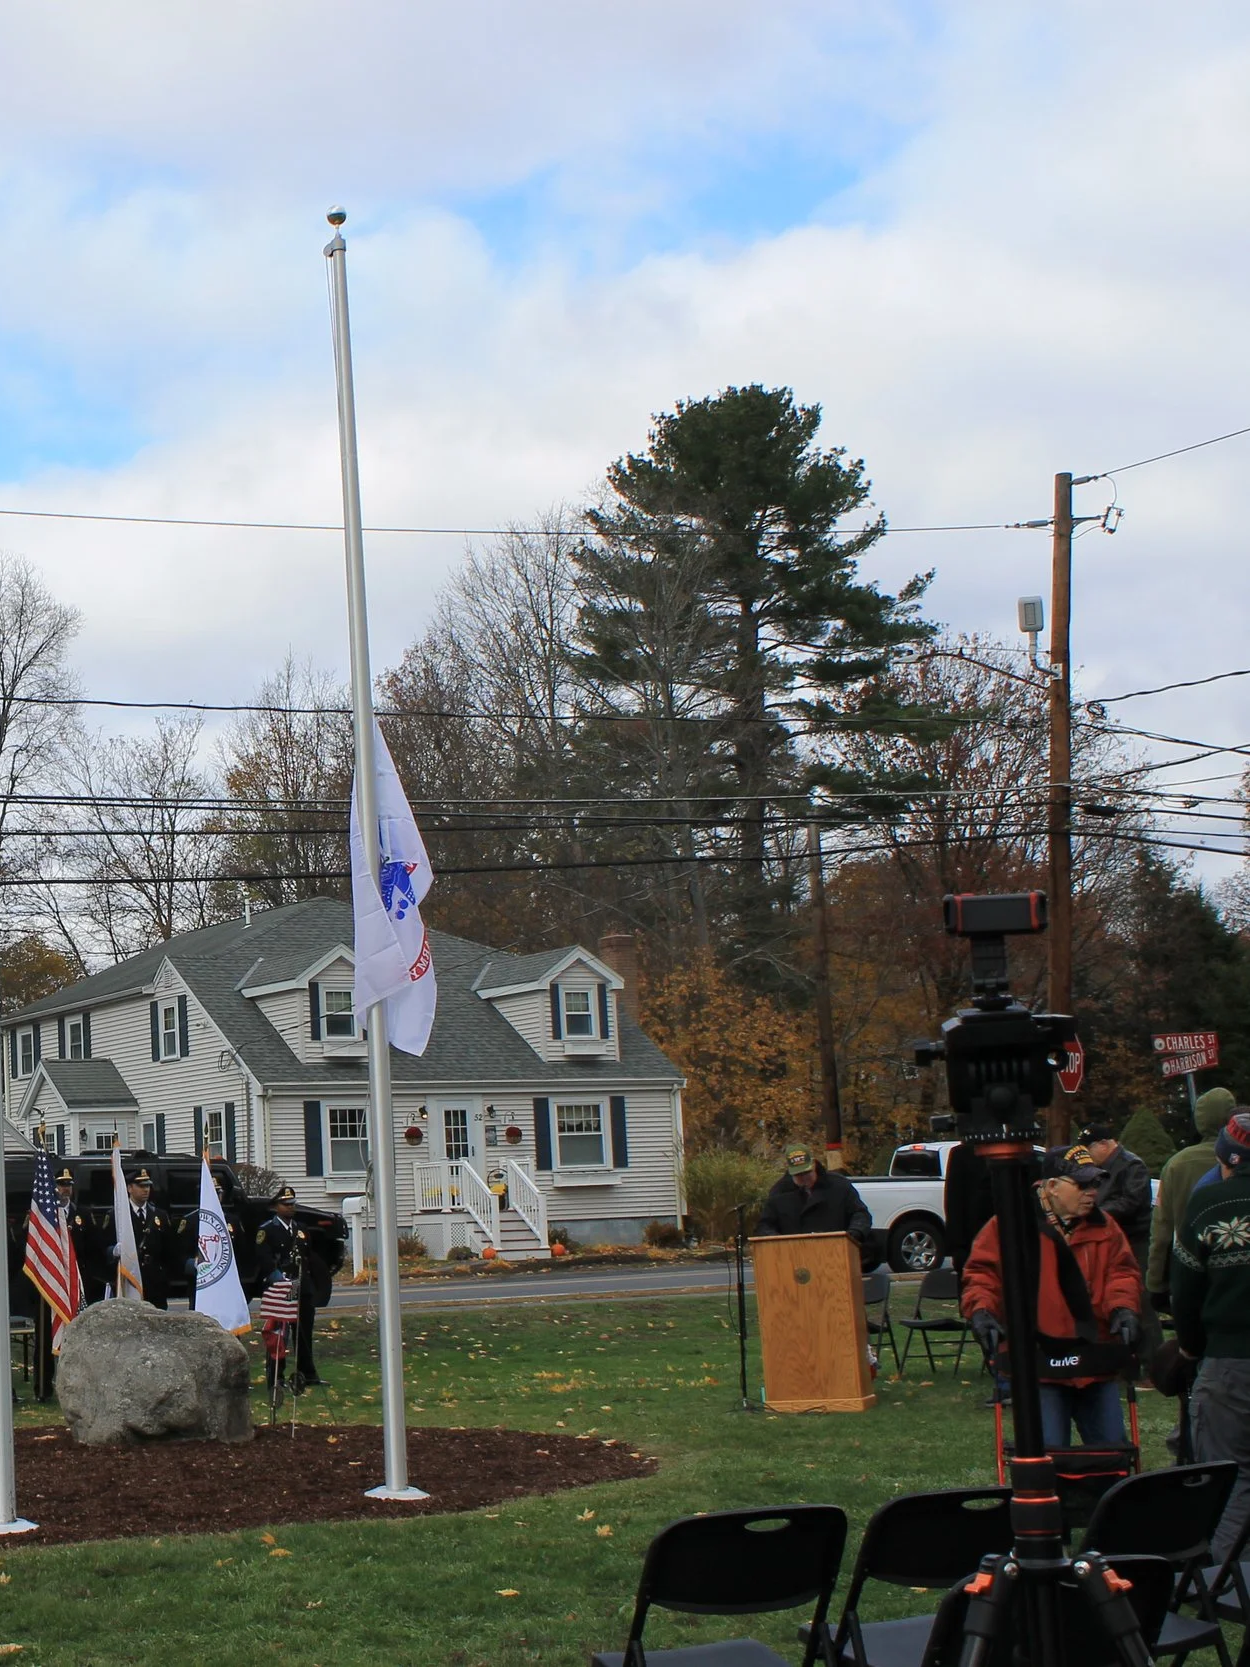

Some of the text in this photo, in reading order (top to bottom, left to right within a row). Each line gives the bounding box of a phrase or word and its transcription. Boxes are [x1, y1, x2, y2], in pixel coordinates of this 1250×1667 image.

[1165, 1034, 1215, 1051] CHARLES ST
[1170, 1049, 1215, 1073] HARRISON ST
[474, 1113, 483, 1121] 52
[199, 1212, 230, 1271] OWN OF READING
